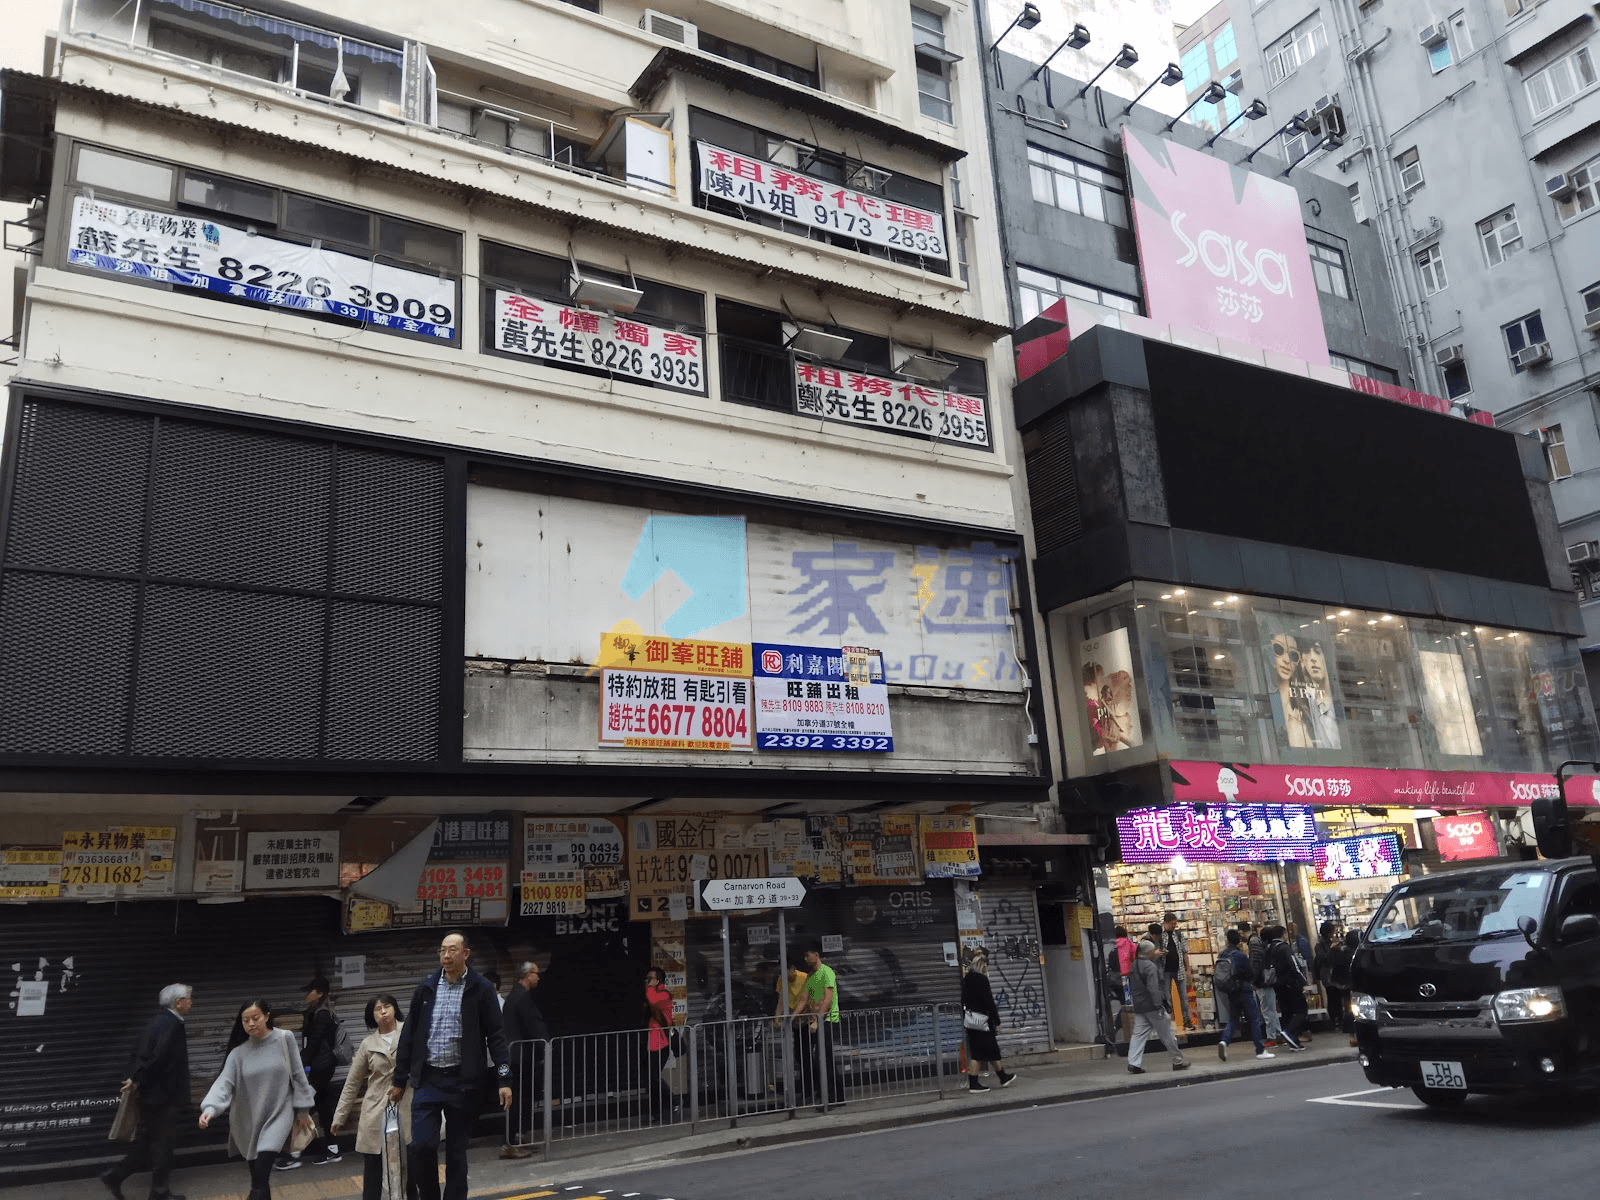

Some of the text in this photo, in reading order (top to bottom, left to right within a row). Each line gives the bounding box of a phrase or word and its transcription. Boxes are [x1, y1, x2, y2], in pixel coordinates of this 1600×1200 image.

[708, 150, 934, 233] 租務代理
[706, 168, 942, 254] 陳小姐 9173 2833
[122, 208, 197, 240] 美華物業
[77, 226, 200, 272] 蘇先生
[218, 256, 332, 299] 8226
[349, 284, 452, 326] 3909
[1216, 285, 1264, 323] 莎莎
[503, 295, 698, 358] 全幢獨家
[501, 318, 700, 389] 黃先生 8226 3935
[797, 363, 983, 417] 租務代理
[797, 383, 987, 443] 鄭先生 8226 3955
[608, 673, 747, 705] 特約放租 有匙引看
[782, 699, 802, 712] 8109
[804, 700, 824, 713] 9883
[846, 702, 865, 715] 8108
[866, 703, 885, 716] 8210
[608, 702, 748, 739] 趙先生 6677 8804
[764, 734, 889, 750] 2392 3392
[1326, 778, 1351, 797] 莎莎
[1394, 780, 1476, 803] making life beautiful
[656, 819, 716, 849] 國金行
[1132, 808, 1226, 850] 龍城
[80, 832, 146, 850] 永昇物業
[267, 838, 321, 850] 未經業主許可
[590, 842, 620, 853] 0434
[77, 855, 129, 864] 93636681
[590, 852, 620, 863] 0075
[895, 852, 913, 862] 3555
[62, 866, 142, 884] 27811682
[265, 867, 320, 880] 違者送官究治
[464, 867, 503, 881] 3459
[635, 855, 677, 884] 古先生
[724, 853, 760, 878] 0071
[523, 885, 583, 900] 8100 8978
[724, 881, 786, 891] Carnarvon Road
[523, 901, 566, 914] 2827 9818
[734, 894, 778, 905] 加拿分道
[888, 890, 933, 908] ORIS
[556, 917, 620, 935] BLANC
[1432, 1063, 1451, 1076] TH
[1426, 1075, 1463, 1087] 5220
[4, 1096, 122, 1113] Heritage Spirit Moonph
